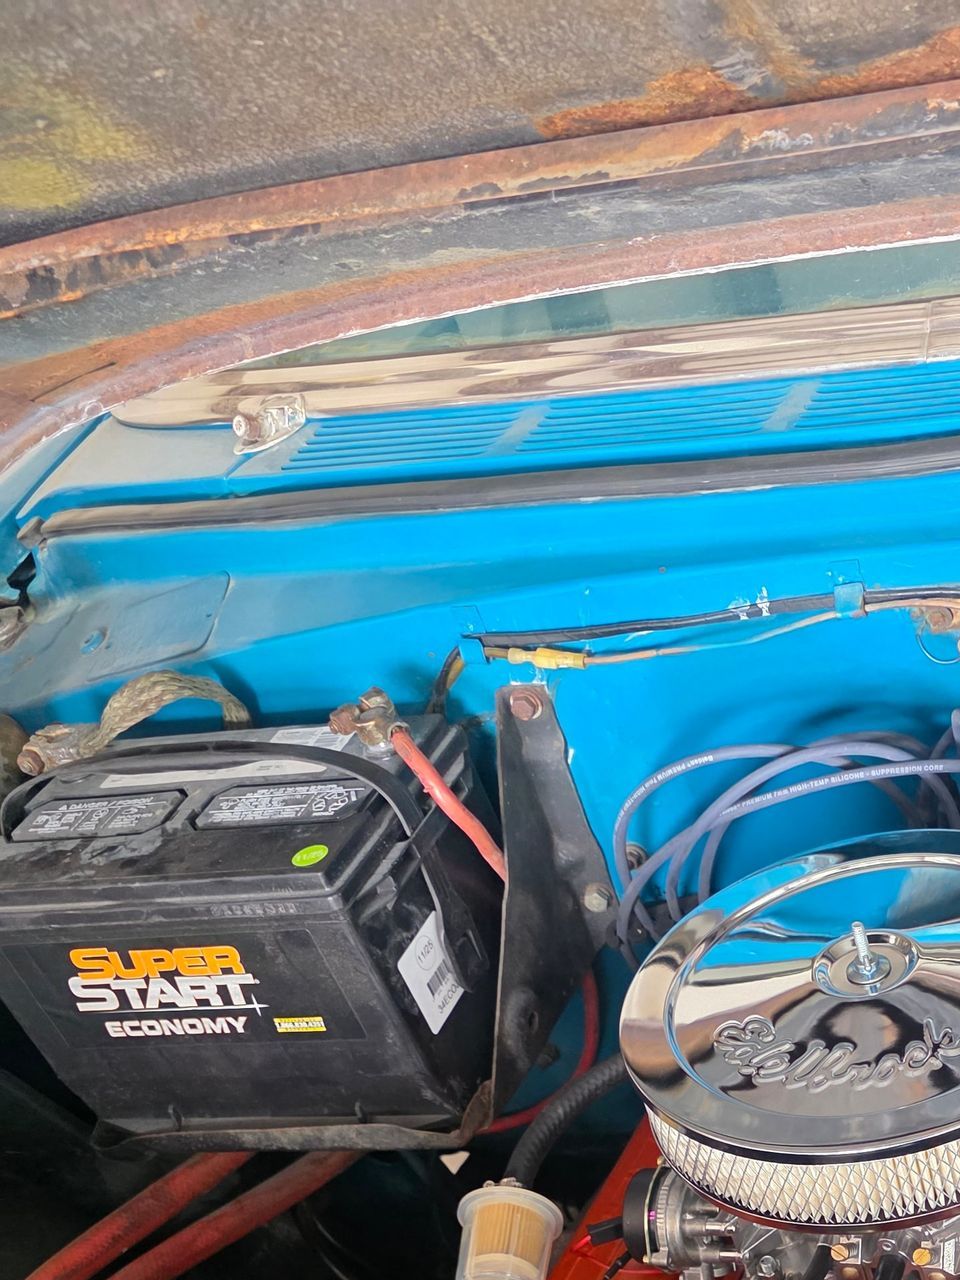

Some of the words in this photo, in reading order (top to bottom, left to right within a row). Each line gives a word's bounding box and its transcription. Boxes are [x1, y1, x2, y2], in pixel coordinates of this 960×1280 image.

[741, 793, 772, 808] PREMIUM
[789, 777, 830, 794] HIGH-TEMP
[870, 766, 922, 777] SUPPRESSION
[923, 764, 944, 772] CORE
[70, 946, 246, 980] SUPER
[417, 941, 434, 963] 11/25
[68, 974, 256, 1012] START
[104, 1016, 248, 1038] ECONOMY
